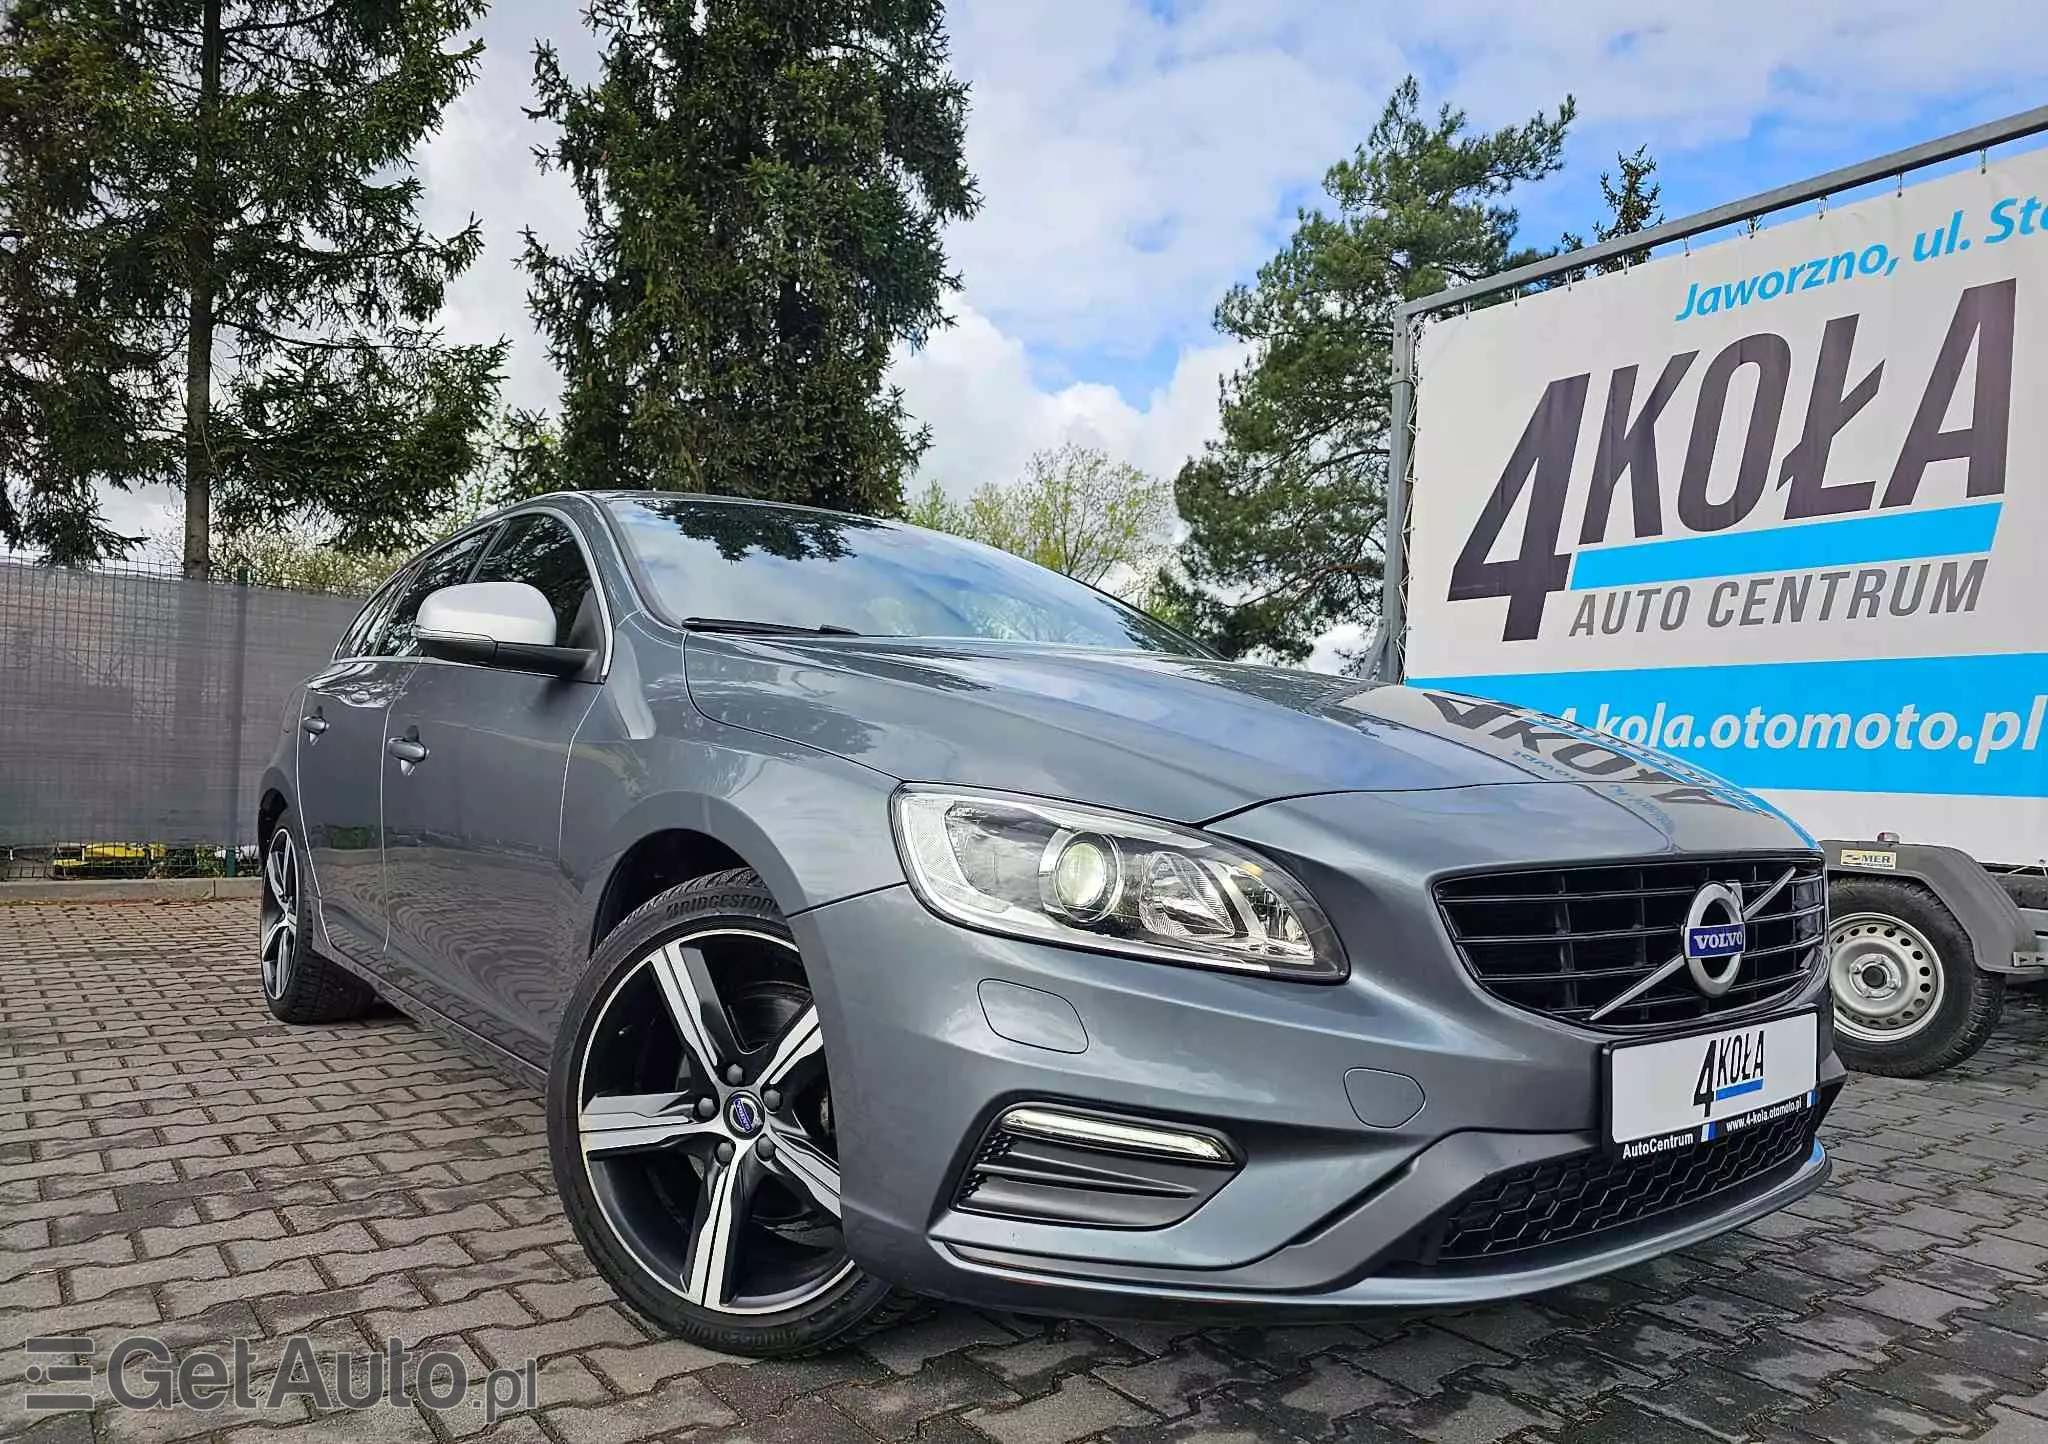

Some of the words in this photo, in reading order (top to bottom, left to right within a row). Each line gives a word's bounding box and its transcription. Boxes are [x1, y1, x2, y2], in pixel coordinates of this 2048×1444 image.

[1675, 243, 1900, 321] Jaworzno,
[1913, 210, 1971, 263] ul.
[1568, 586, 1691, 637] AUTO
[1707, 558, 1989, 629] CENTRUM
[1693, 931, 1743, 950] VOLVO
[1726, 1097, 1802, 1132] www.4-kola.otomoto.pl
[1622, 1133, 1694, 1160] AutoCentrum
